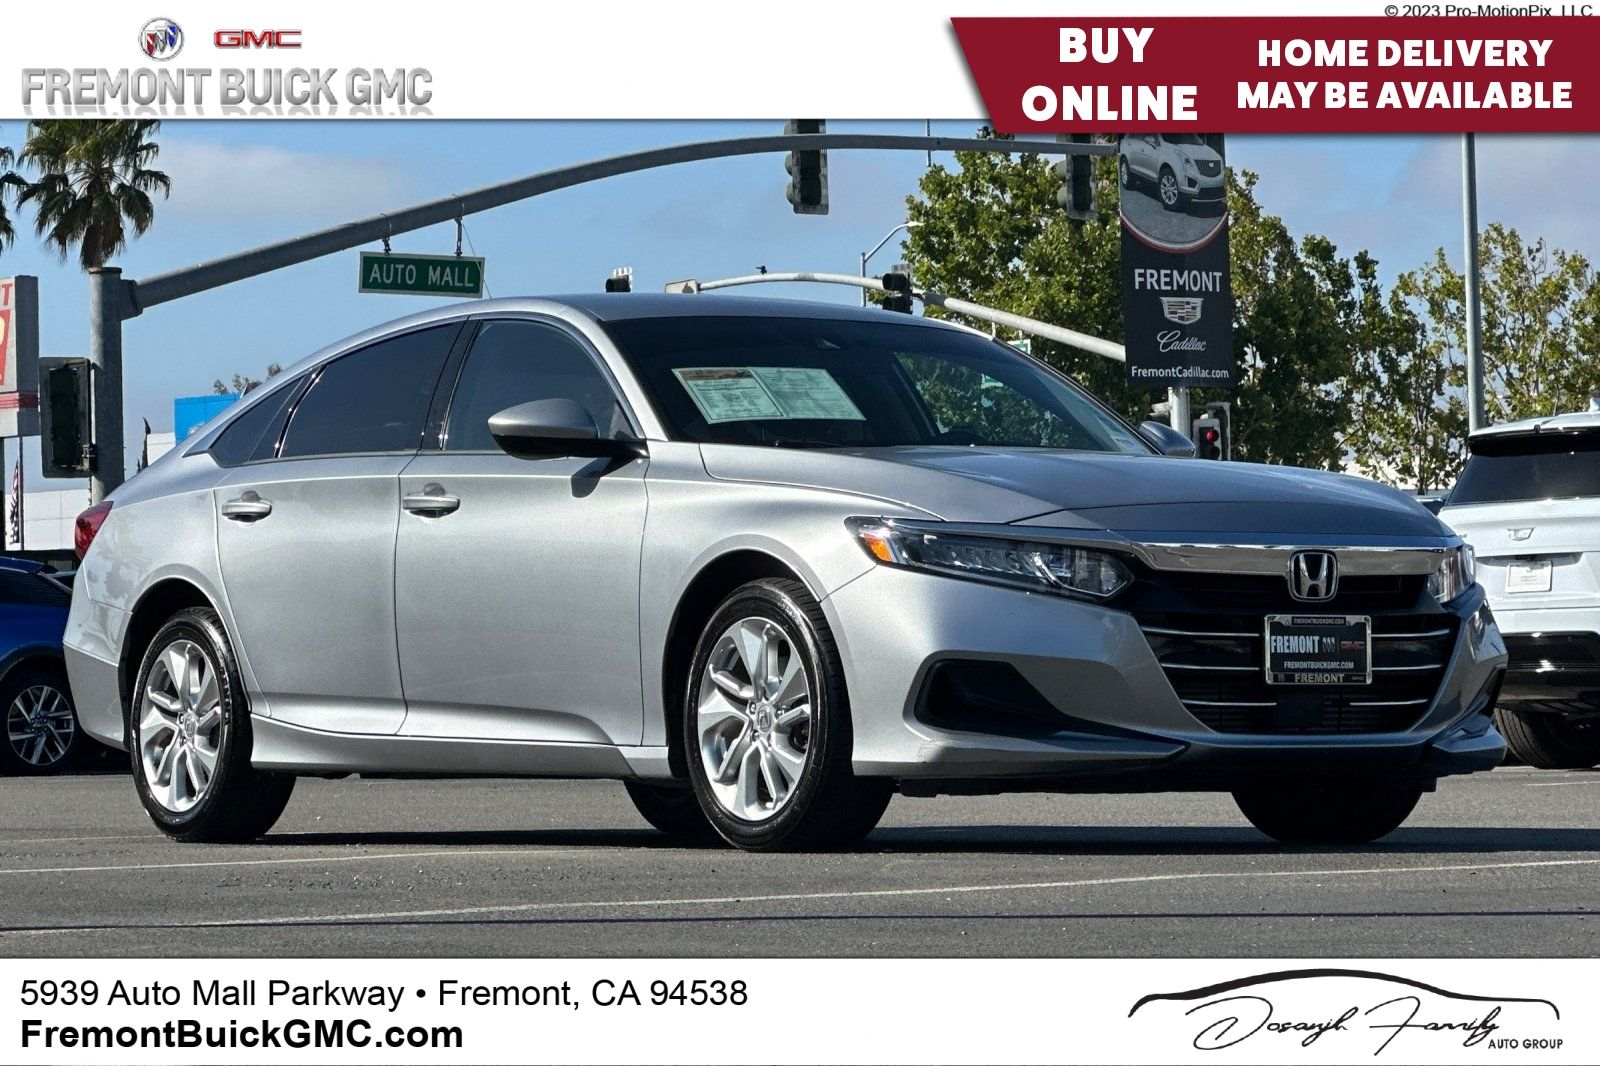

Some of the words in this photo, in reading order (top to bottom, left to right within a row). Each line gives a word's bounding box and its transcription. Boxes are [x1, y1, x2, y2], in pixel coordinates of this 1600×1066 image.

[369, 263, 416, 285] AUTO
[428, 265, 473, 287] MALL
[1134, 269, 1222, 292] FREMONT
[1157, 330, 1206, 352] Cadillac
[1131, 365, 1229, 379] FremontCadillac.com
[1271, 636, 1319, 653] FREMONT
[1295, 674, 1344, 682] FREMONT
